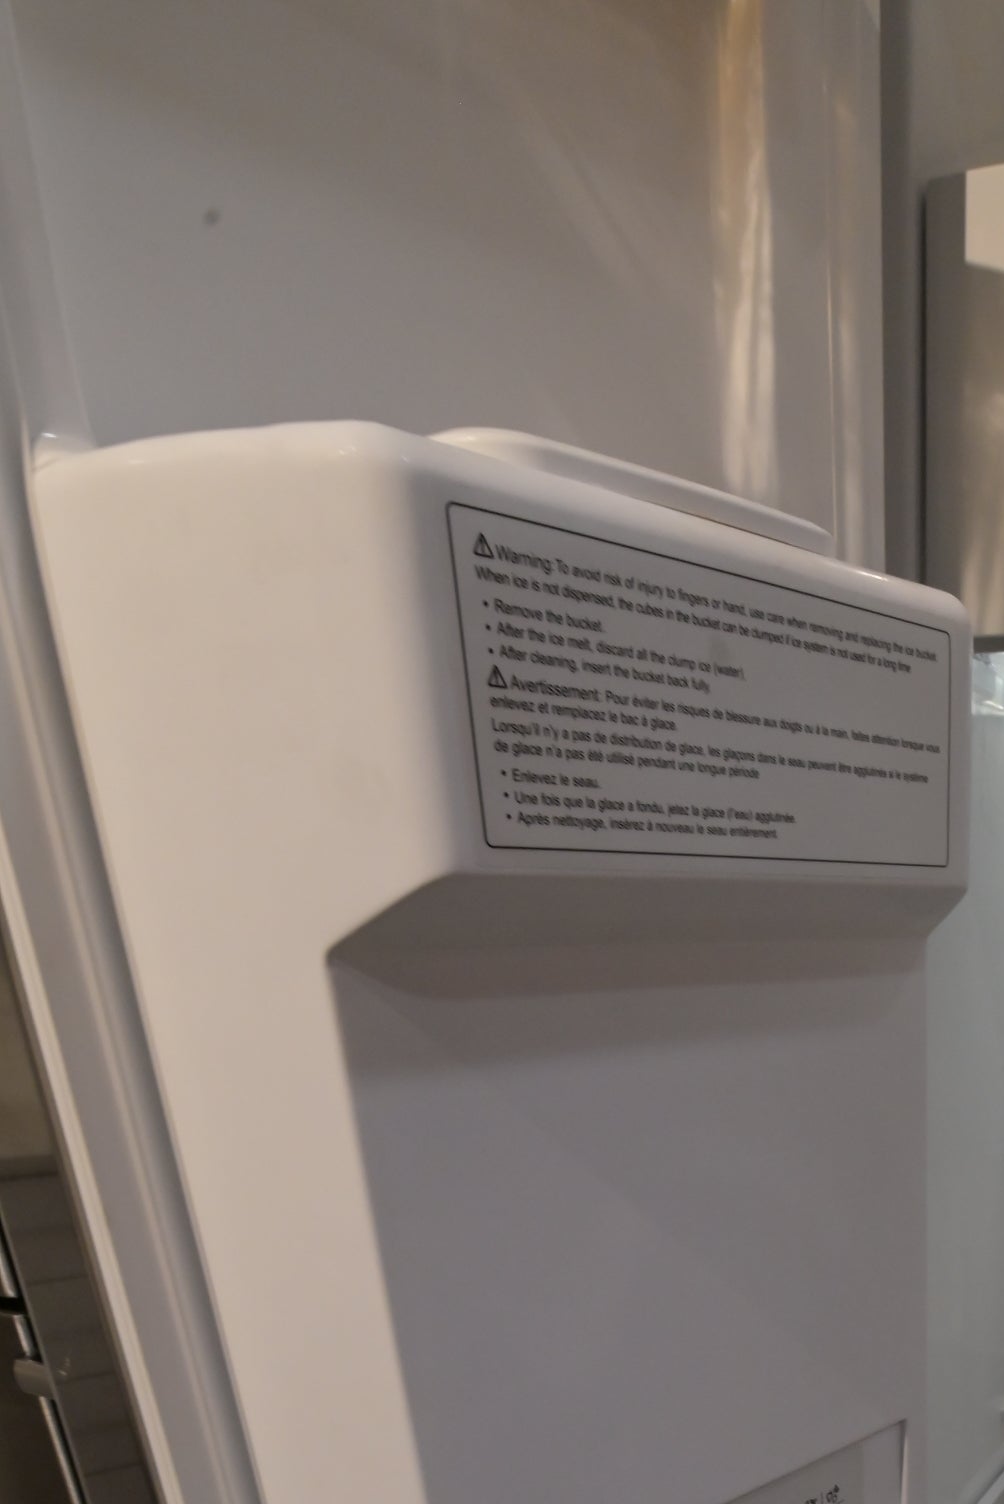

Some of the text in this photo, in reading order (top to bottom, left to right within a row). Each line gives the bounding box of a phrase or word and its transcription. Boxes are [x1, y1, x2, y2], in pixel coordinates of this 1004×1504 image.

[494, 543, 554, 576] Warning:
[554, 558, 569, 576] To
[571, 562, 601, 583] avoid
[602, 569, 622, 588] risk
[623, 574, 634, 591] of
[636, 577, 662, 601] injury
[665, 585, 676, 601] to
[677, 587, 710, 612] fingers
[710, 598, 720, 611] or
[748, 607, 764, 621] use
[474, 564, 511, 585] When
[511, 572, 529, 589] ice
[530, 577, 540, 592] is
[542, 579, 560, 596] not
[617, 596, 633, 612] the
[634, 600, 664, 619] cubes
[665, 607, 674, 621] in
[675, 609, 690, 625] the
[691, 613, 720, 631] bucket
[722, 623, 737, 635] can
[738, 624, 749, 638] be
[751, 627, 783, 648] clumped
[493, 597, 544, 621] Remove
[544, 608, 563, 625] the
[495, 620, 525, 639] After
[527, 626, 546, 643] the
[547, 630, 565, 646] ice
[595, 639, 634, 659] discard
[635, 647, 648, 661] all
[649, 649, 665, 664] the
[667, 653, 696, 672] clump
[697, 658, 711, 673] ice
[498, 643, 527, 661] After
[581, 658, 611, 675] insert
[612, 663, 630, 679] the
[631, 666, 665, 684] bucket
[666, 673, 689, 688] back
[489, 693, 536, 712] enlevez
[537, 700, 549, 714] et
[550, 702, 607, 724] remplacez
[608, 710, 617, 723] le
[619, 712, 639, 726] bac
[604, 690, 630, 707] Pour
[661, 699, 675, 714] les
[676, 701, 710, 721] risques
[712, 707, 724, 721] de
[725, 709, 761, 726] blessure
[493, 738, 509, 752] de
[510, 740, 543, 758] glace
[564, 748, 585, 763] pas
[636, 754, 676, 772] pendant
[677, 761, 695, 772] une
[696, 761, 726, 777] longue
[561, 729, 569, 740] a
[571, 730, 592, 745] pas
[592, 730, 607, 744] de
[609, 732, 662, 751] distribution
[663, 739, 677, 753] de
[707, 745, 720, 758] les
[757, 751, 776, 765] dans
[511, 767, 558, 785] Enlevez
[558, 772, 570, 786] le
[513, 790, 538, 805] Une
[539, 792, 561, 806] fois
[562, 796, 584, 811] que
[585, 795, 596, 809] la
[597, 796, 625, 813] glace
[627, 801, 634, 811] a
[666, 802, 689, 818] jetez
[690, 804, 699, 816] la
[700, 805, 725, 820] glace
[654, 822, 695, 834] nouveau
[696, 822, 705, 834] le
[706, 825, 728, 836] seau
